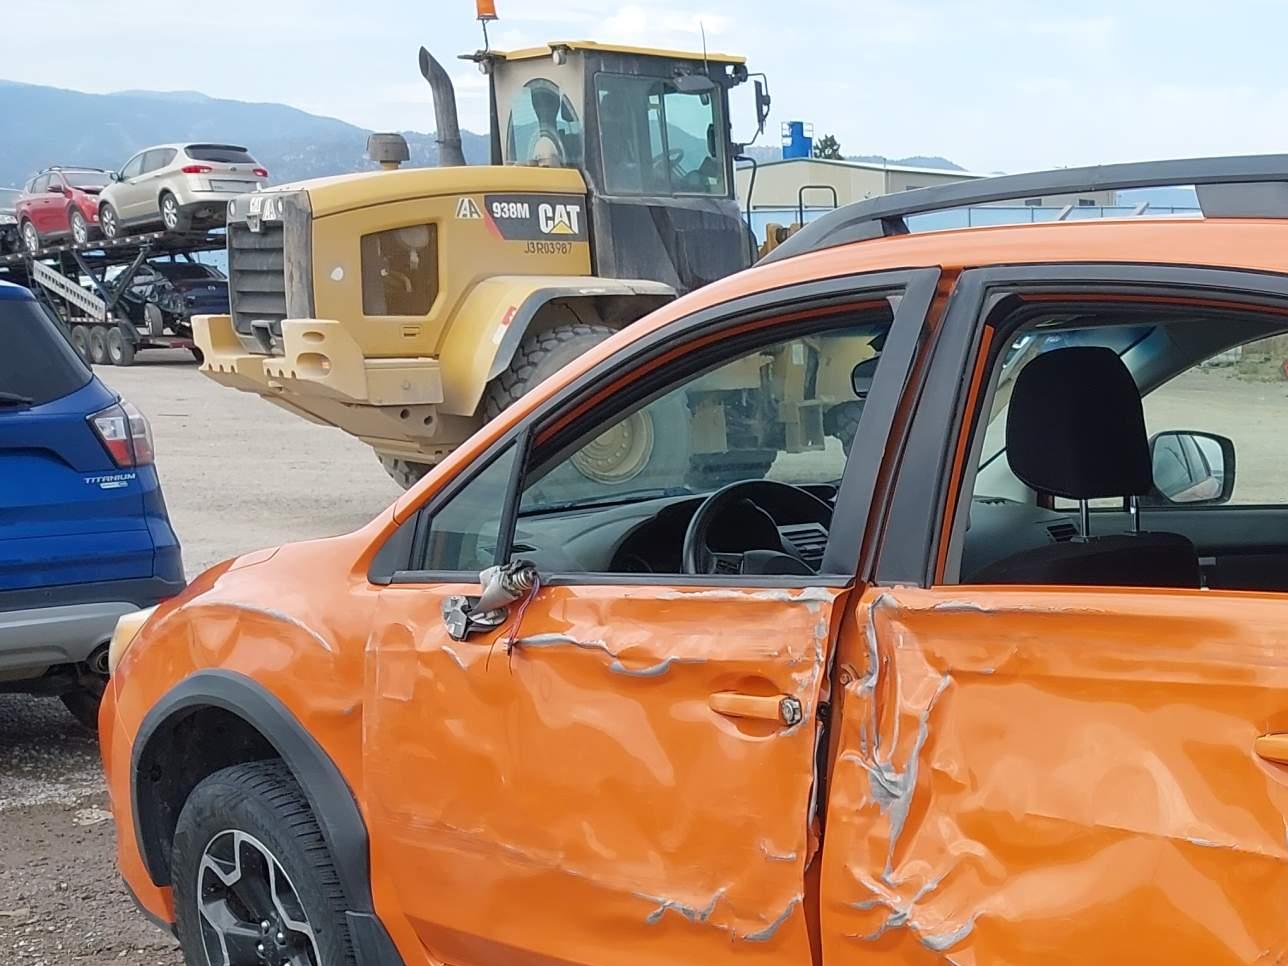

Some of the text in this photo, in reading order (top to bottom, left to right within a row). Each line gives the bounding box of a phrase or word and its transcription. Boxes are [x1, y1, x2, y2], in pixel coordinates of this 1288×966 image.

[492, 202, 530, 219] 938M
[538, 203, 581, 234] CAT
[85, 473, 136, 484] TITANIUM
